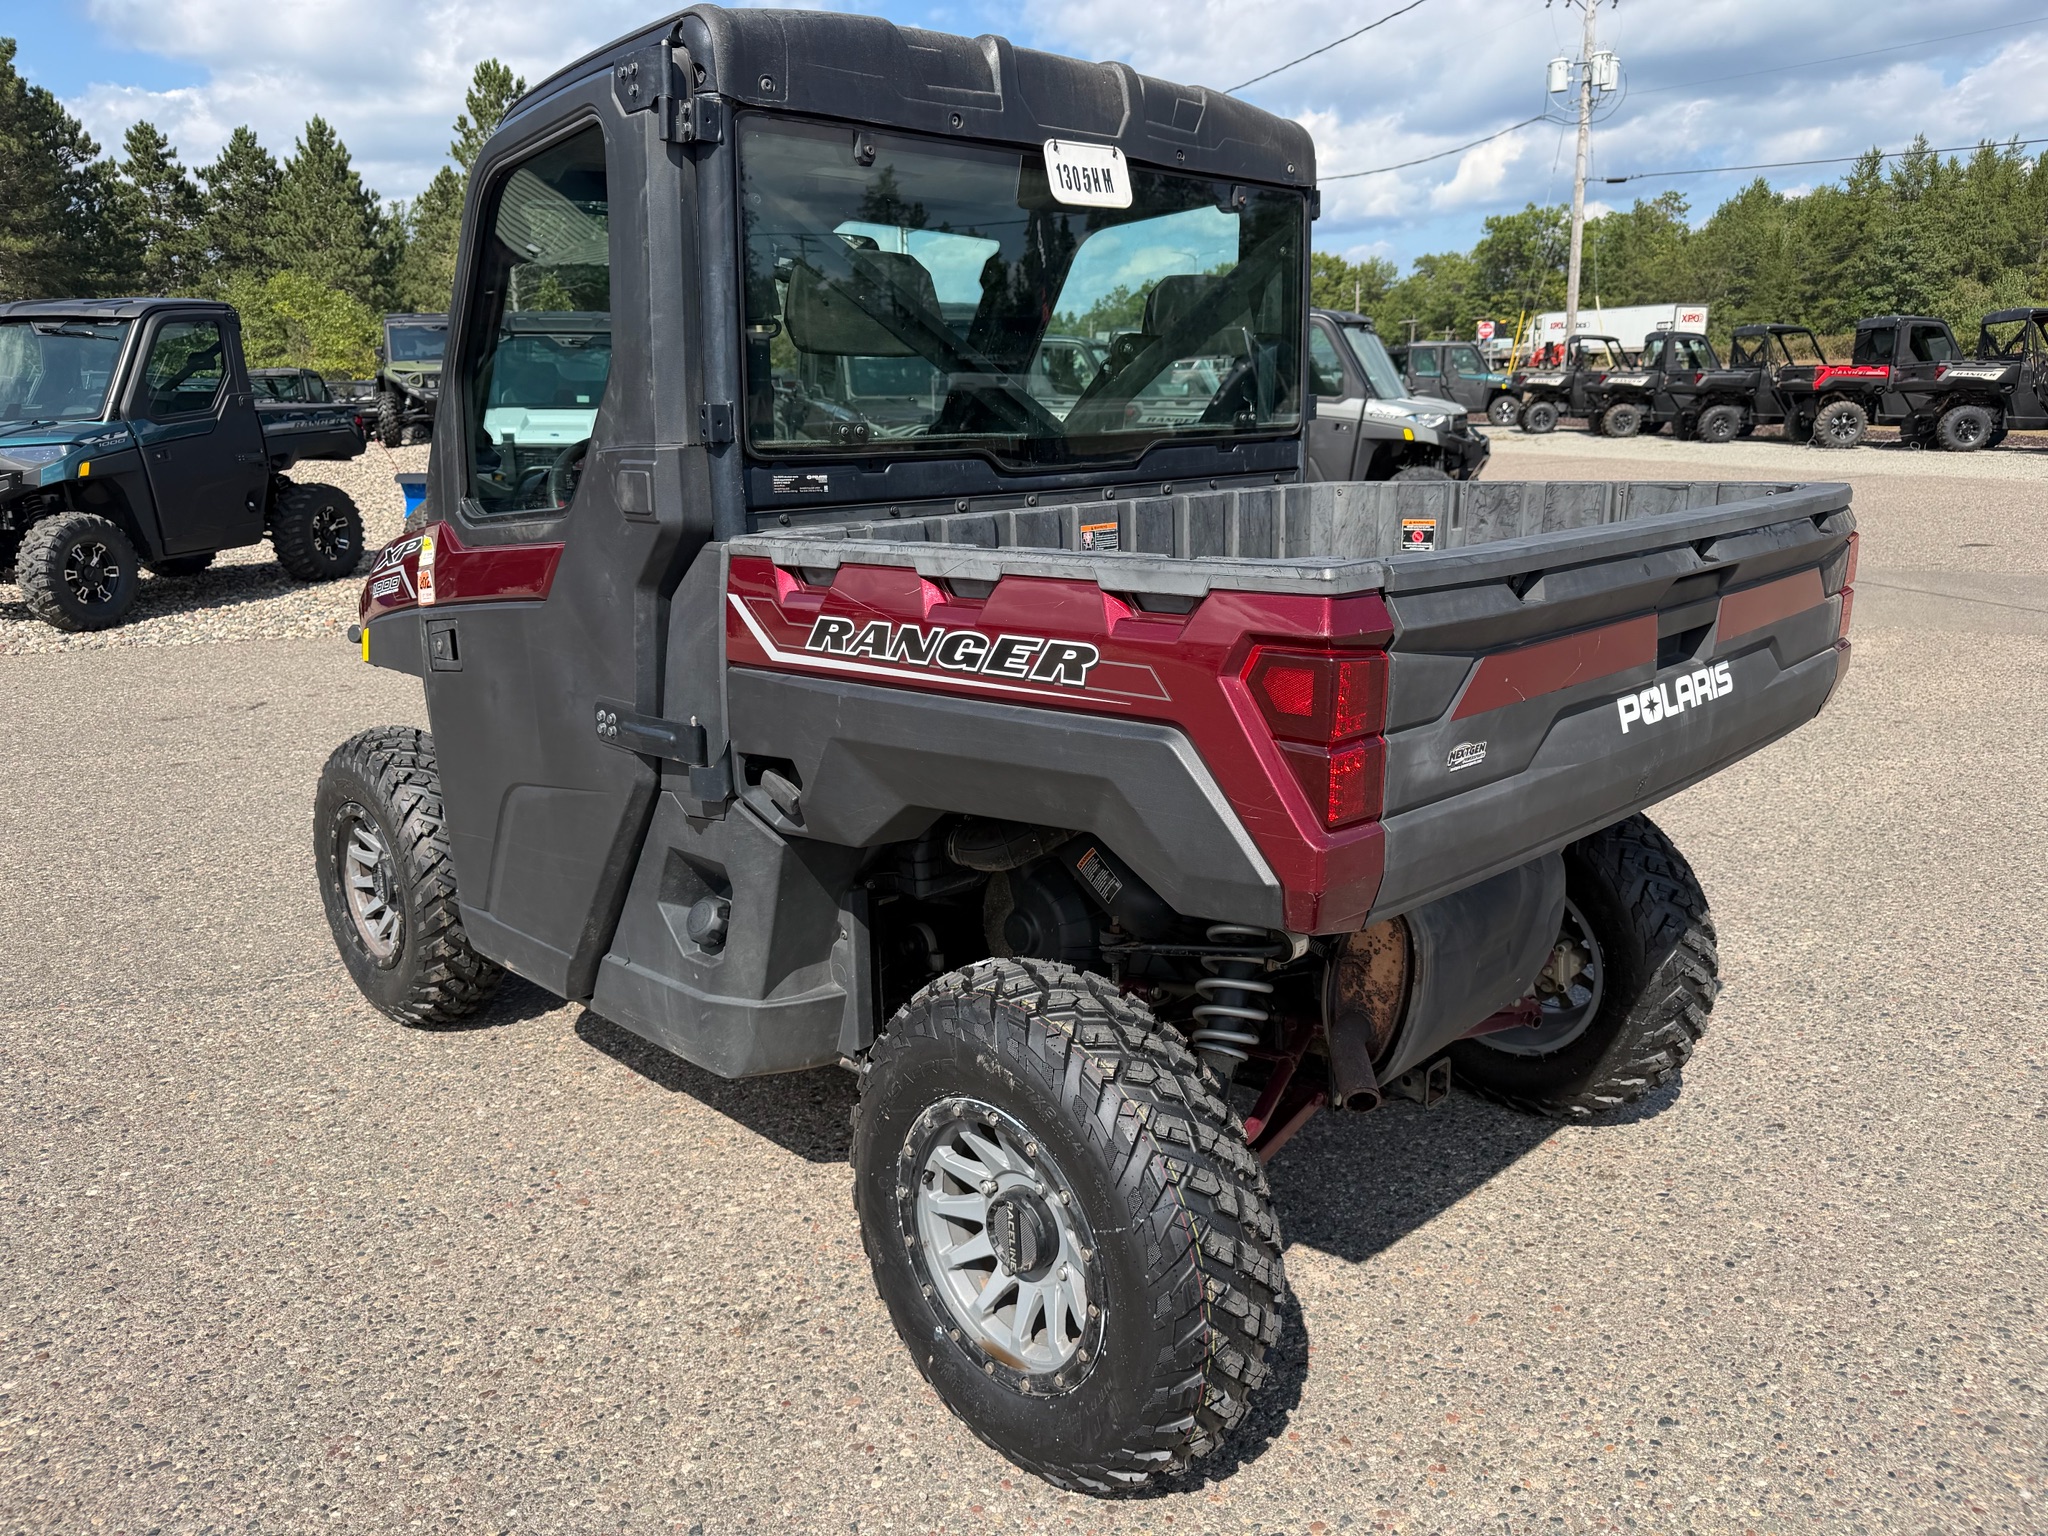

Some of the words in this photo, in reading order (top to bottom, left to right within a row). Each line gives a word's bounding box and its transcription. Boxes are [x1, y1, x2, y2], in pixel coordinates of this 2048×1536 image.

[1056, 163, 1115, 195] 1305HM
[1681, 314, 1700, 323] XPO
[99, 437, 126, 448] 1000
[372, 536, 423, 573] XP
[372, 576, 401, 596] 1000
[804, 615, 1100, 690] RANGER
[1616, 660, 1734, 735] POLARIS
[1006, 1201, 1018, 1273] RACELINE
